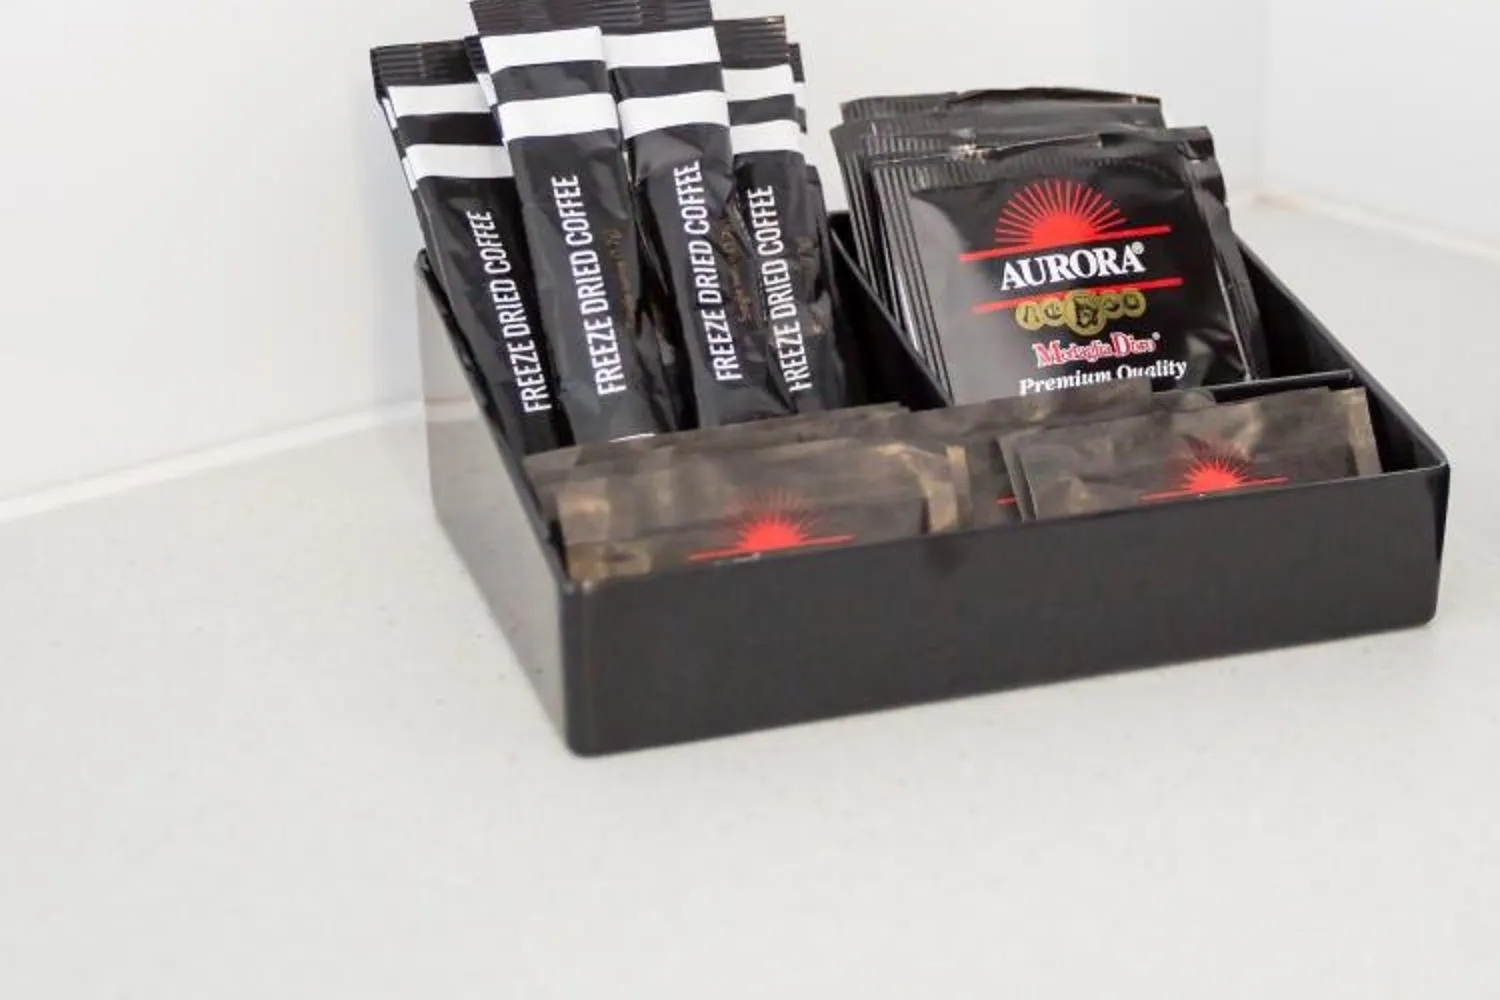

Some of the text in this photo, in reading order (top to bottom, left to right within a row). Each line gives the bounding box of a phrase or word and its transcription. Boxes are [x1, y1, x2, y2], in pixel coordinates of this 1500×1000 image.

[550, 173, 593, 246] COFFEE
[673, 160, 710, 235] COFFEE
[569, 250, 609, 315] DRIED
[688, 239, 722, 304] DRIED
[747, 185, 813, 392] FREEZE DRIED COFFEE
[1001, 243, 1147, 291] AURORA
[466, 210, 552, 413] FREEZE DRIED COFFEE
[702, 307, 743, 381] FREEZE
[583, 316, 627, 394] FREEZE
[1019, 360, 1188, 396] Premium Quality
